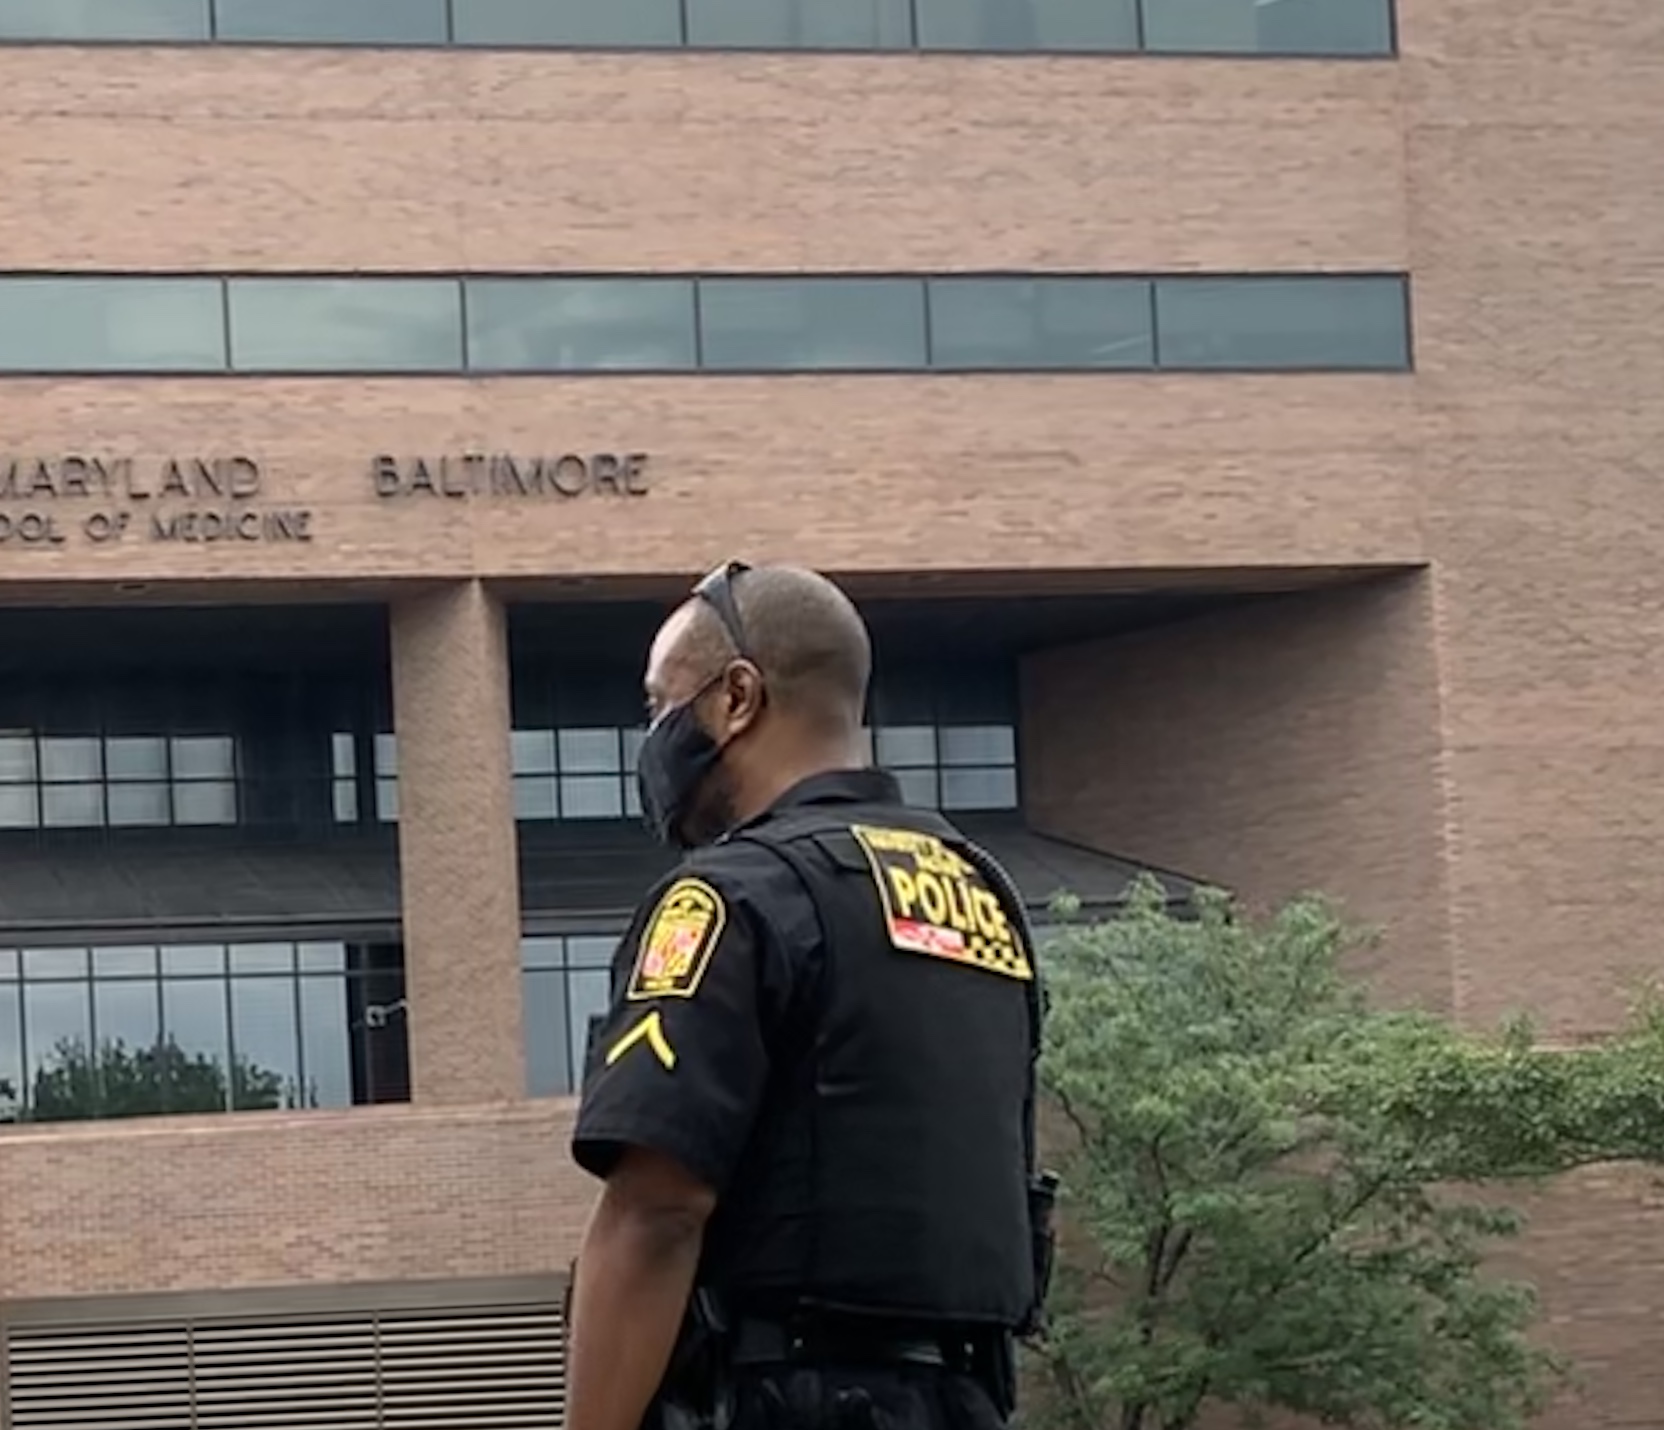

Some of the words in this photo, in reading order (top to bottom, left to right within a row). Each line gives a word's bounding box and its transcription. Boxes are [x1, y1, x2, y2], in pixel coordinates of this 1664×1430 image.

[372, 453, 650, 498] BALTIMORE
[83, 512, 133, 542] OF
[151, 510, 313, 543] MEDICINE
[887, 864, 1012, 944] POLICE
